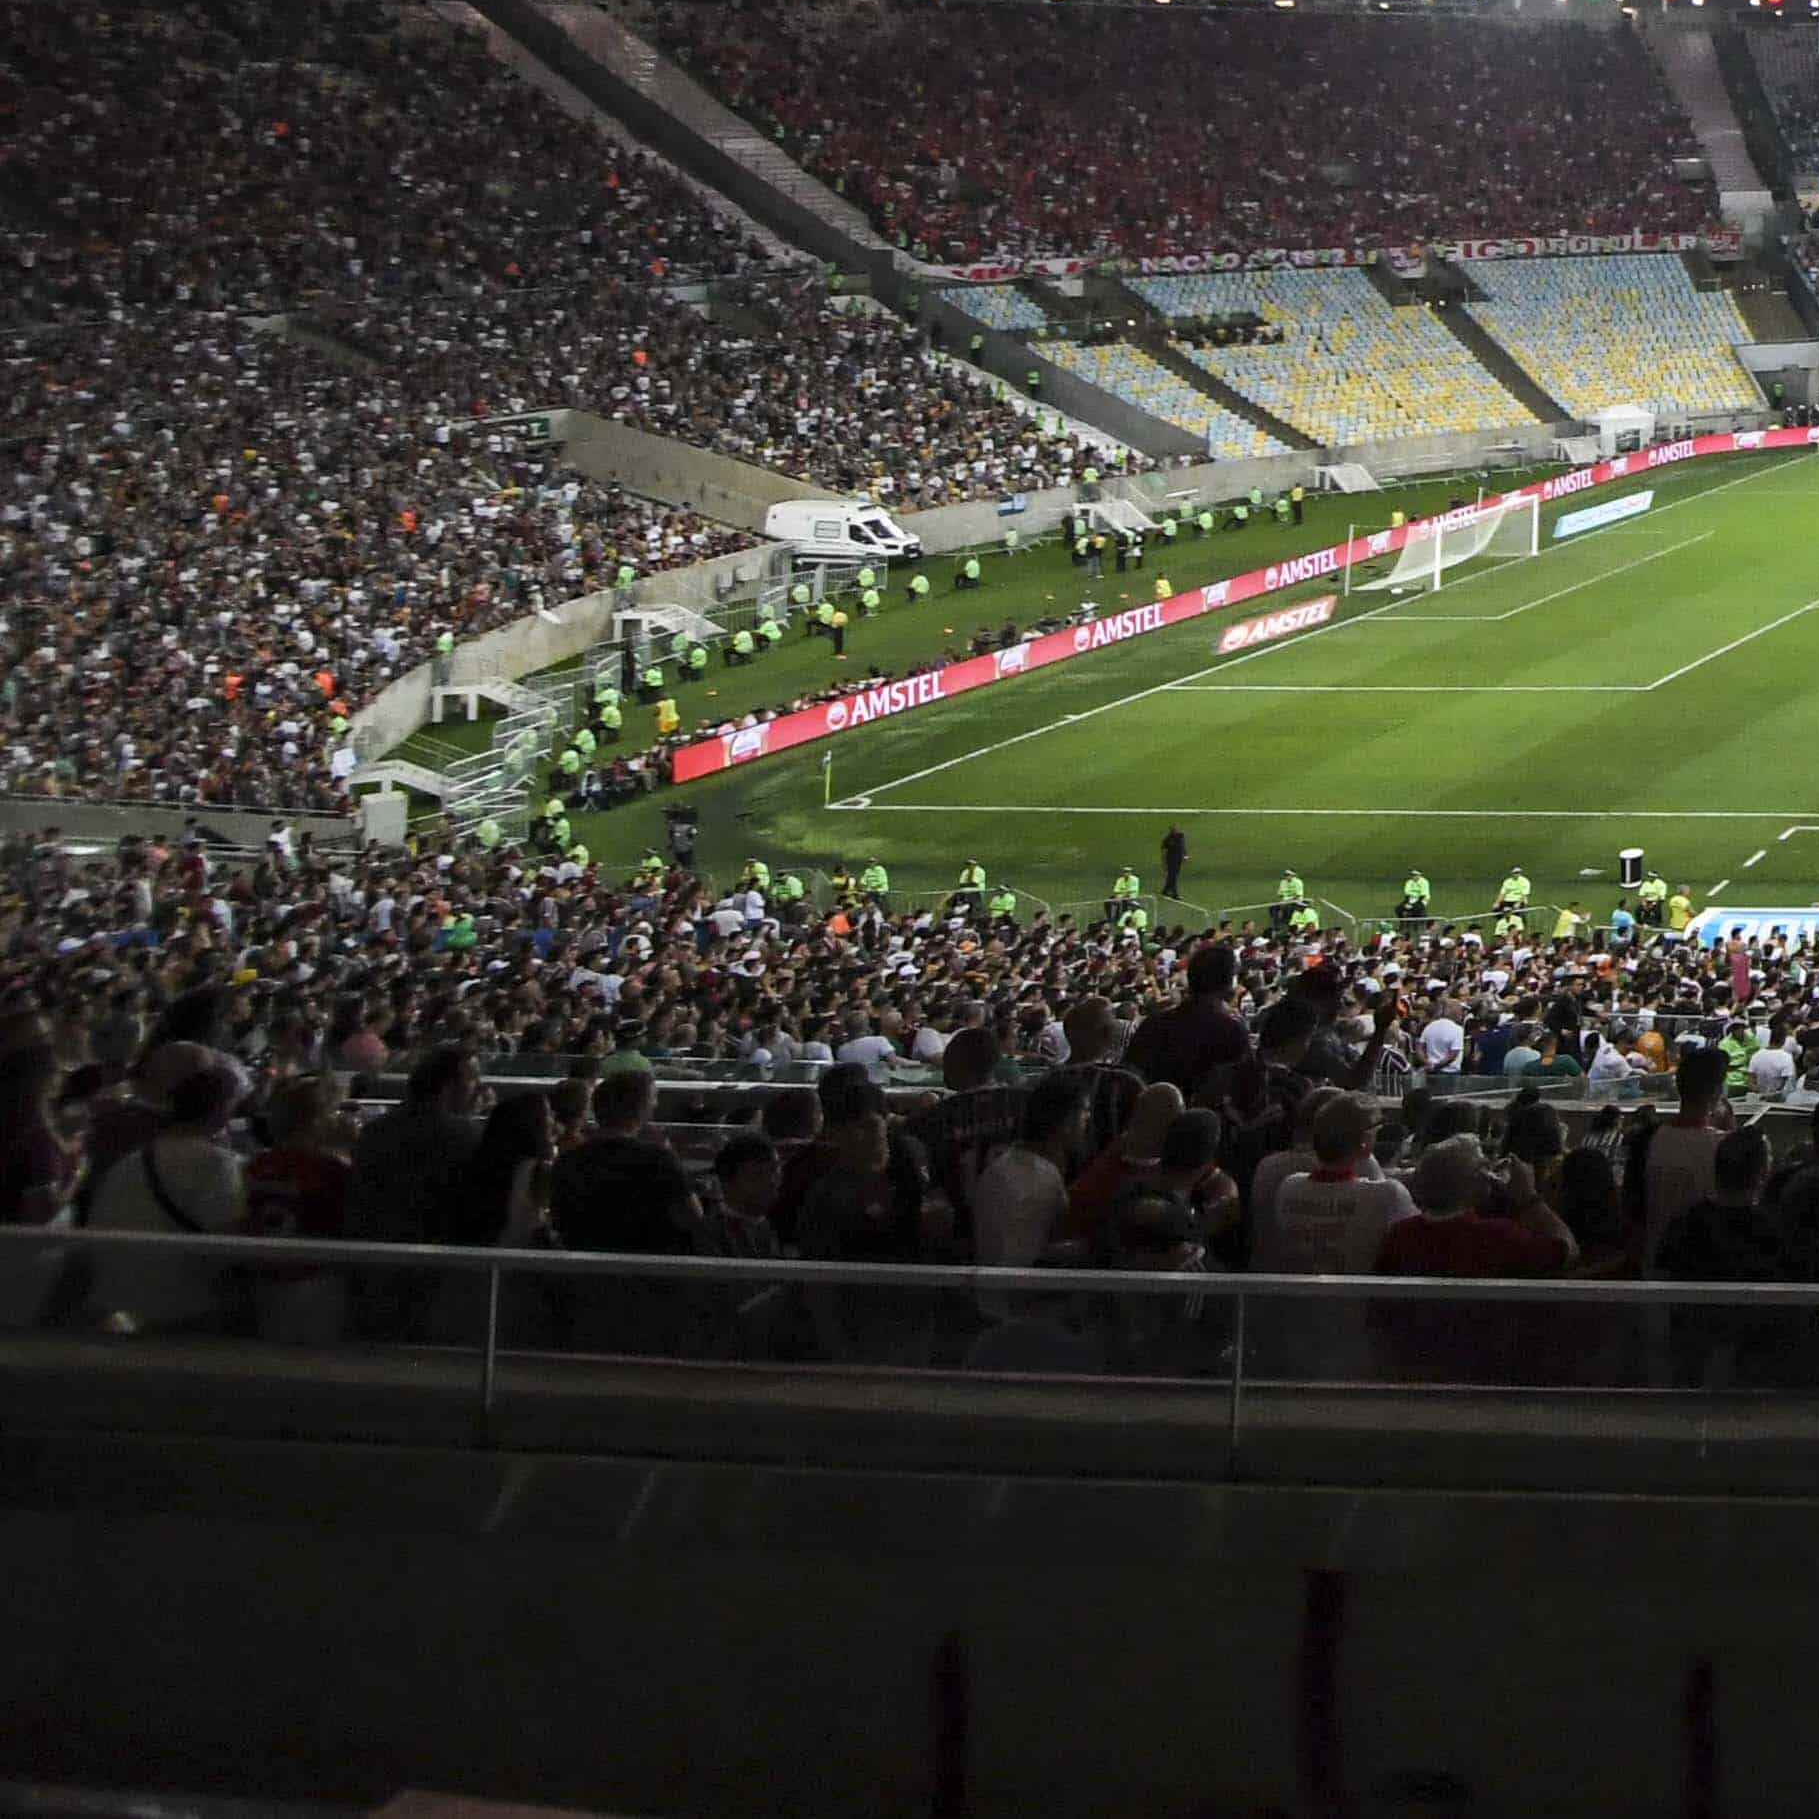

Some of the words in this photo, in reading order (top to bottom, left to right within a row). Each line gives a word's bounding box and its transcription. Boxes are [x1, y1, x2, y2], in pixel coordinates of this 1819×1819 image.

[1657, 440, 1697, 465] AMSTEL
[1553, 468, 1596, 498] AMSTEL
[1280, 548, 1338, 587] AMSTEL
[1092, 602, 1165, 648] AMSTEL
[1246, 602, 1331, 643] AMSTEL
[850, 670, 945, 726] AMSTEL
